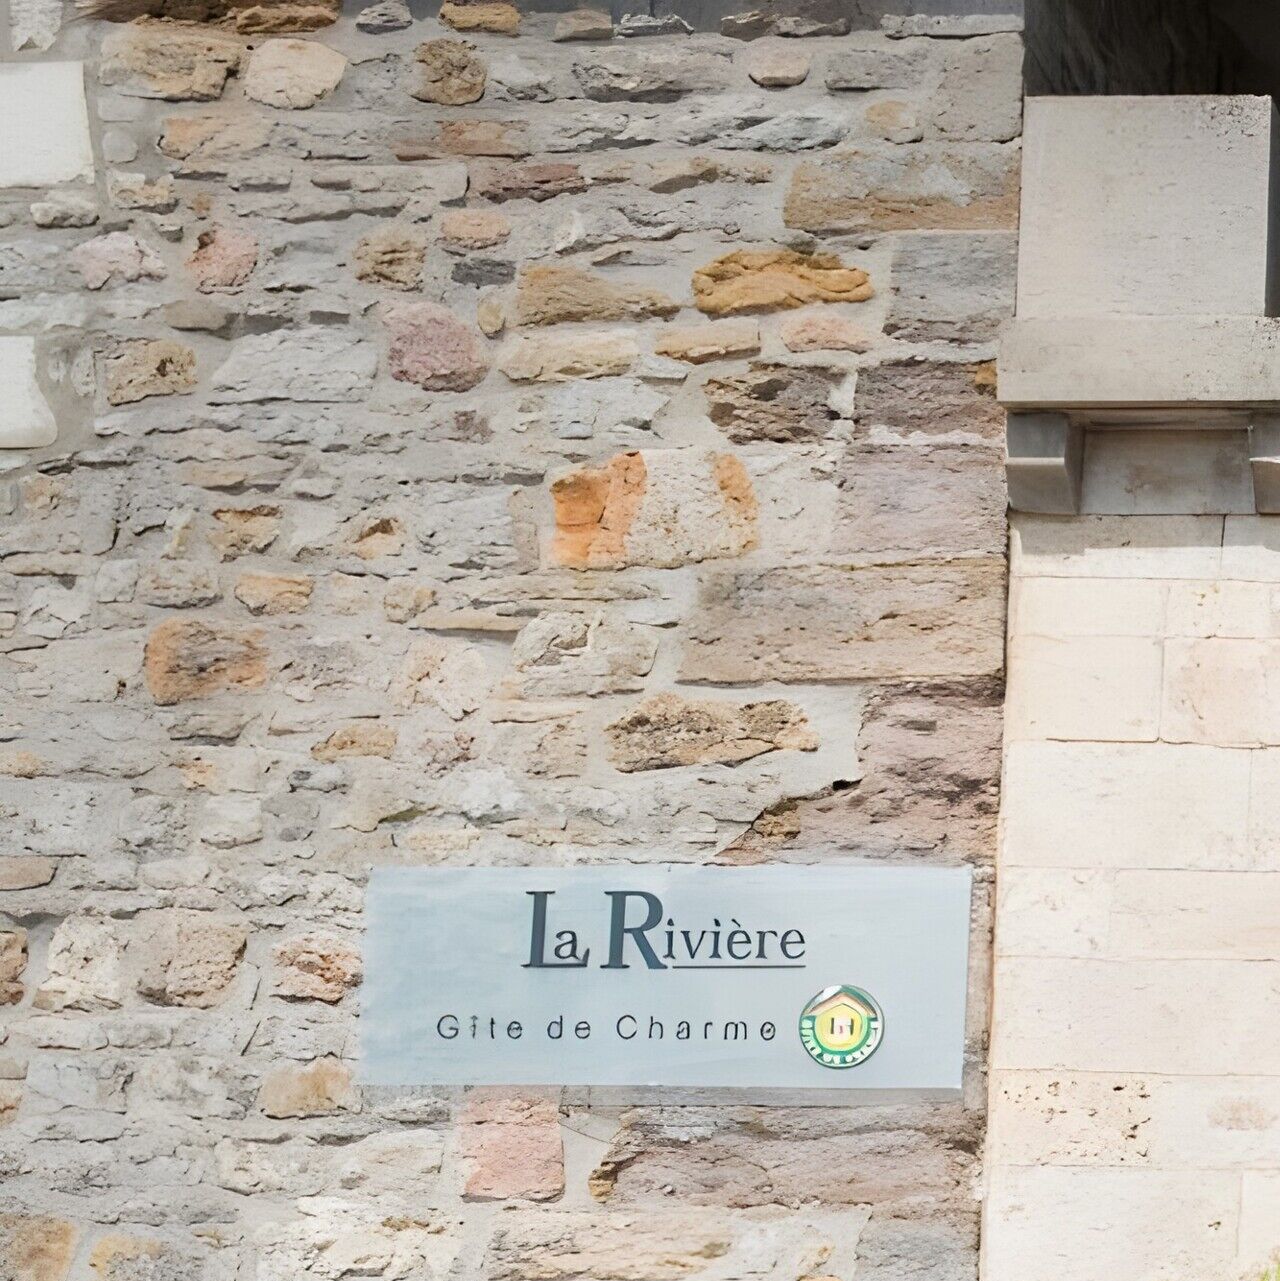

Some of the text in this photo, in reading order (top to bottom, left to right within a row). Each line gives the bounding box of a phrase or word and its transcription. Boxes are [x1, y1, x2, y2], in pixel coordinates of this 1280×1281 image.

[520, 890, 806, 970] La Rivière
[546, 1014, 591, 1040] de
[616, 1014, 776, 1041] Charme
